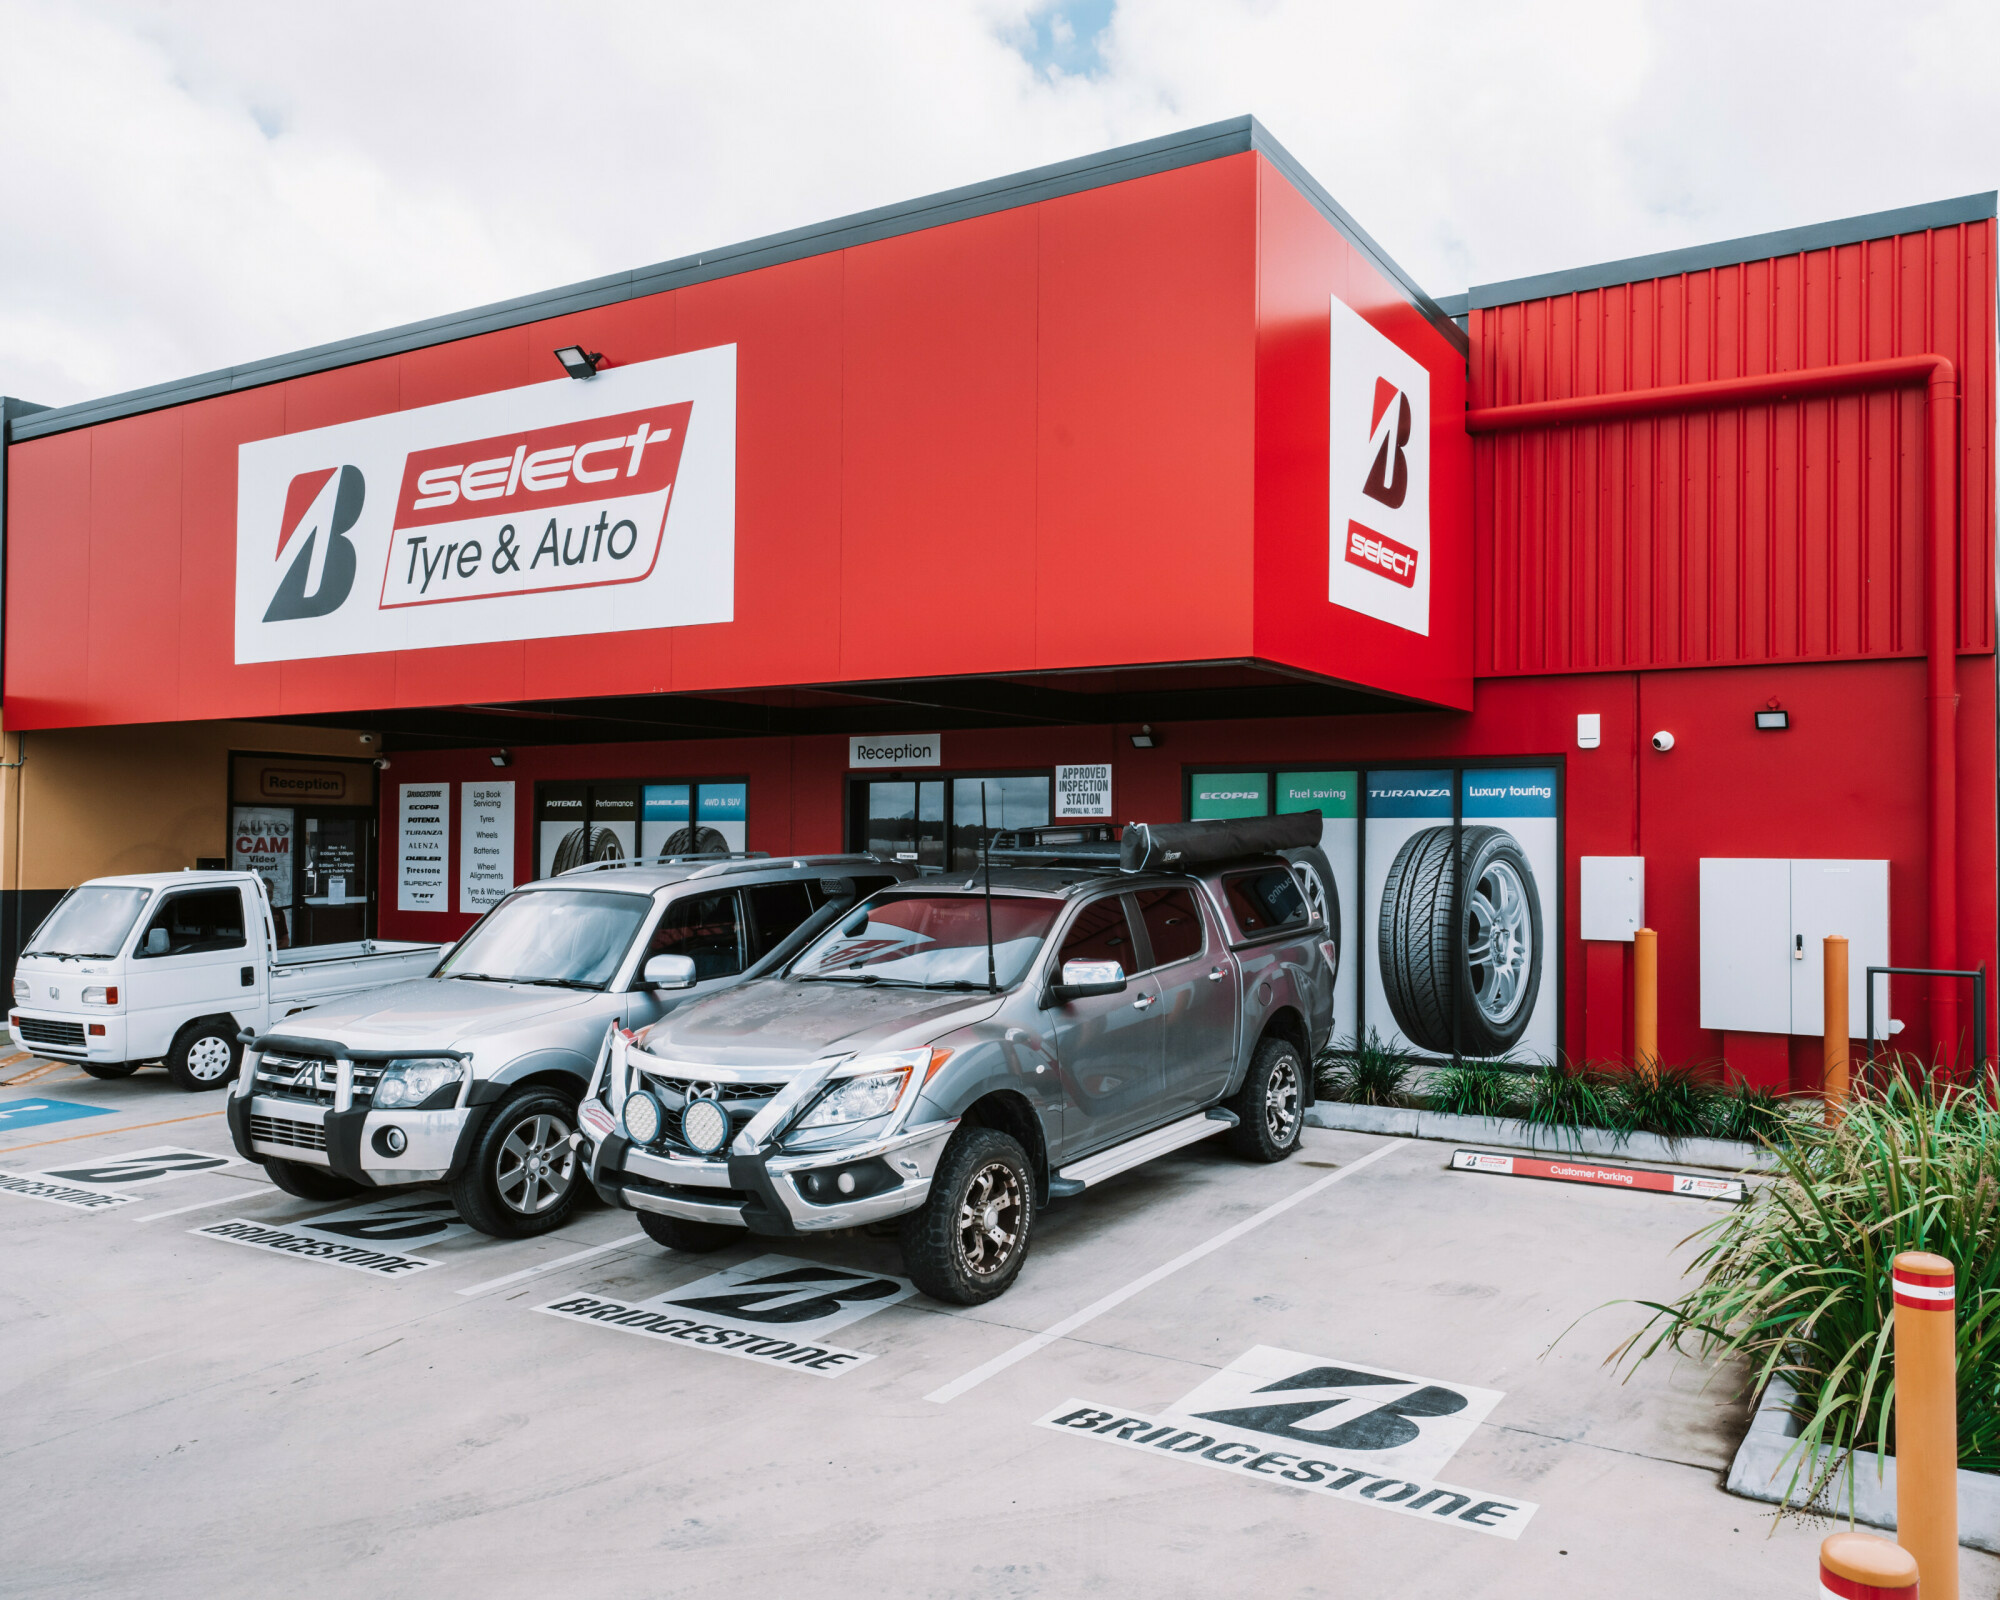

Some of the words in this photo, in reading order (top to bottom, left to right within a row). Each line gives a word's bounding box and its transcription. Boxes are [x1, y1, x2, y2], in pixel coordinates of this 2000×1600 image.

[407, 536, 481, 594] Tyre
[492, 524, 521, 572] &
[531, 511, 638, 570] Auto
[857, 744, 932, 762] Reception
[1062, 766, 1107, 779] APPROVED
[269, 776, 339, 791] Reception
[1058, 779, 1108, 792] INSPECTION
[406, 790, 442, 798] BRIDGESTONE
[473, 790, 484, 799] Log
[486, 790, 501, 798] Book
[1289, 789, 1310, 798] Fuel
[1313, 788, 1346, 800] saving
[1369, 789, 1450, 798] TURANZA
[1469, 786, 1507, 798] Luxury
[1509, 785, 1551, 799] touring
[473, 800, 501, 808] Servicing
[704, 798, 719, 806] 4WD
[720, 798, 726, 806] &
[727, 798, 741, 806] SUV
[1066, 793, 1101, 805] STATION
[1062, 807, 1083, 815] APPROVAL
[480, 815, 495, 824] Tyres
[236, 820, 290, 836] AUTO
[476, 831, 498, 839] Wheels
[236, 836, 289, 854] CAM
[473, 847, 500, 855] Batteries
[246, 864, 278, 872] Report
[406, 866, 440, 875] Firestone
[469, 872, 504, 881] Alignments
[467, 887, 479, 896] Tyre
[471, 897, 501, 906] Package
[1550, 1165, 1595, 1178] Customer
[1597, 1170, 1633, 1184] Parking
[201, 1222, 428, 1273] BRIDGESTONE
[547, 1297, 858, 1370] BRIDGESTONE
[1051, 1408, 1520, 1527] BRIDGESTONE
